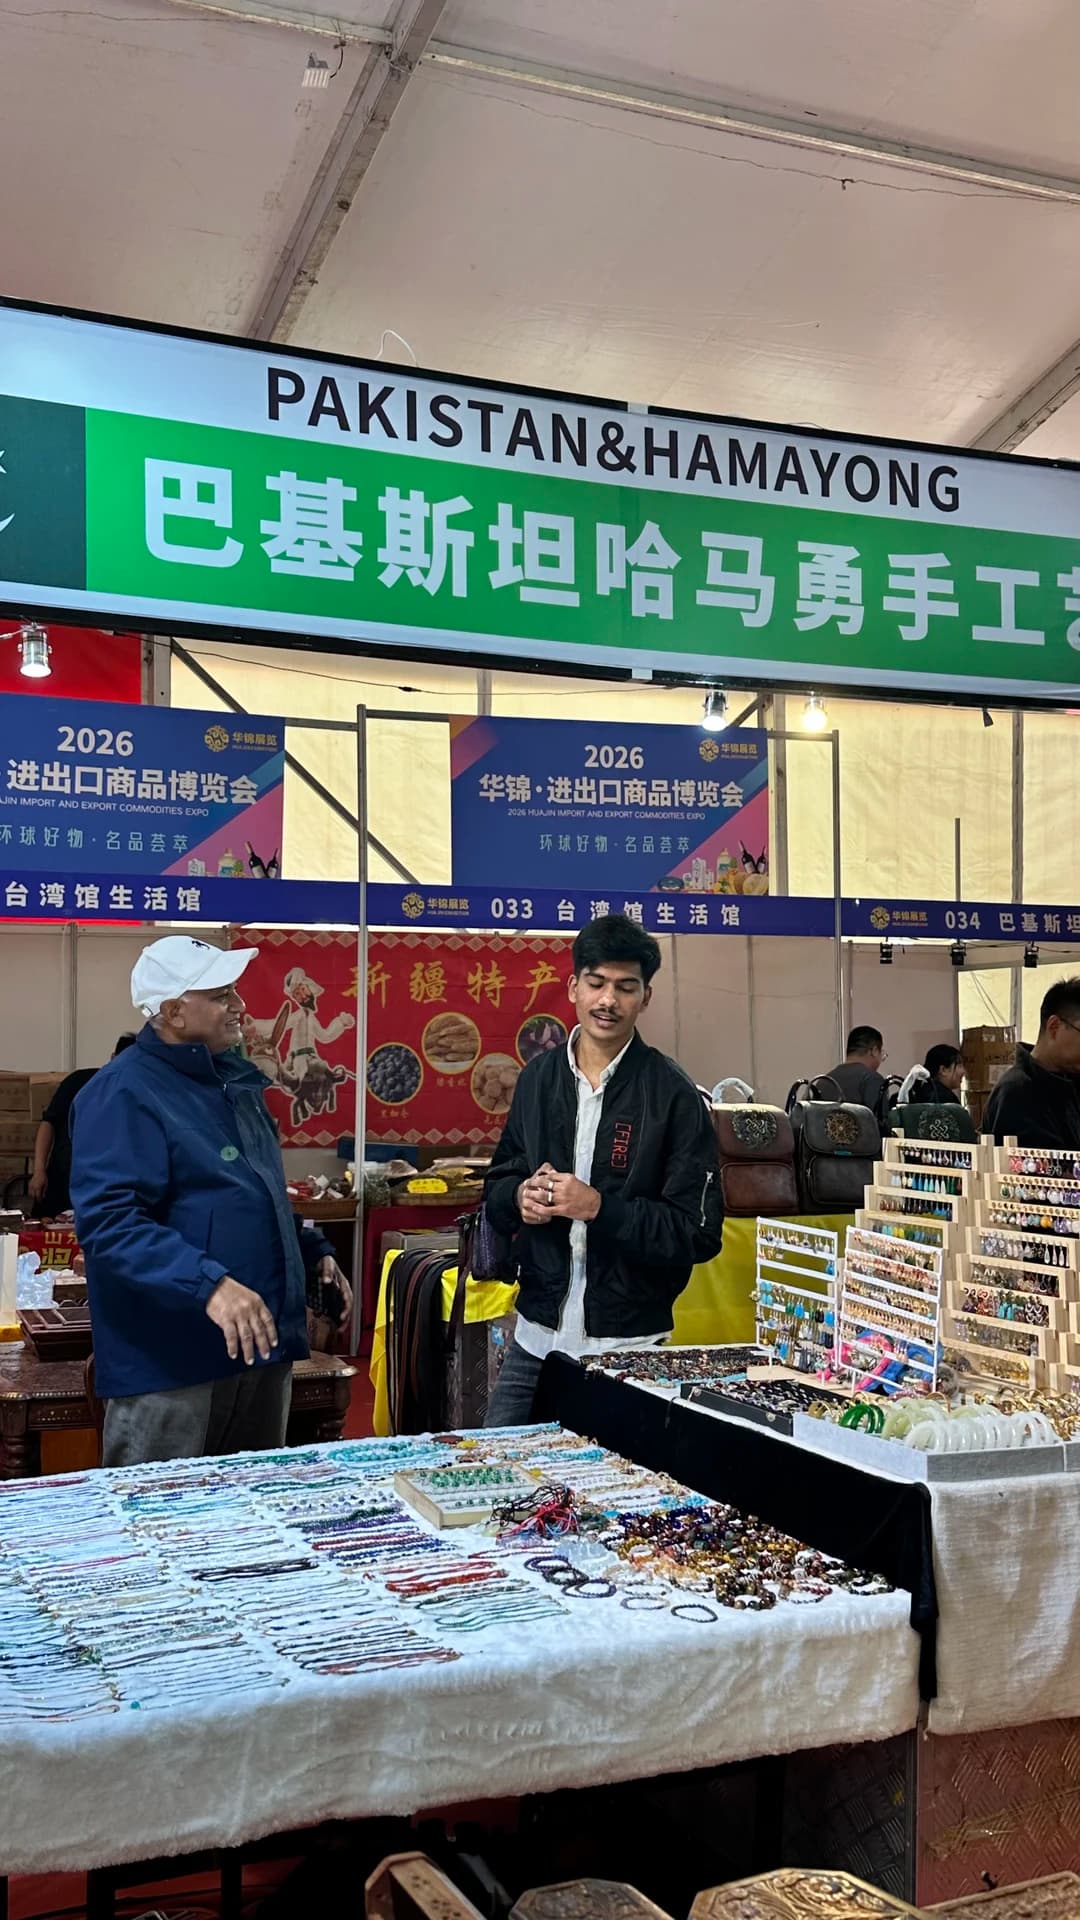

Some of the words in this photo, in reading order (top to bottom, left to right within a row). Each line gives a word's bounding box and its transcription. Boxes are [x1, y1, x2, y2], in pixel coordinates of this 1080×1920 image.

[267, 367, 960, 512] PAKISTAN&HAMAYONG
[57, 726, 134, 757] 2026
[584, 744, 644, 769] 2026
[7, 759, 258, 804] 进出口商品博览会
[478, 774, 744, 808] 华锦·进出口商品博览会
[20, 798, 56, 808] IMPORT
[59, 800, 79, 809] AND
[81, 802, 118, 812] EXPORT
[119, 803, 183, 816] COMMODITIES
[185, 807, 209, 817] EXPO
[507, 808, 527, 817] 2026
[528, 809, 556, 818] HUAJIN
[557, 809, 586, 819] IMPORT
[587, 810, 604, 819] AND
[605, 811, 633, 820] EXPORT
[634, 811, 686, 821] COMMODITIES
[687, 812, 706, 821] EXPO
[5, 881, 201, 912] 台湾馆生活馆
[491, 897, 533, 919] 033
[945, 911, 981, 930] 034
[999, 912, 1080, 934] 巴基斯坦
[341, 960, 561, 1013] 新疆特产
